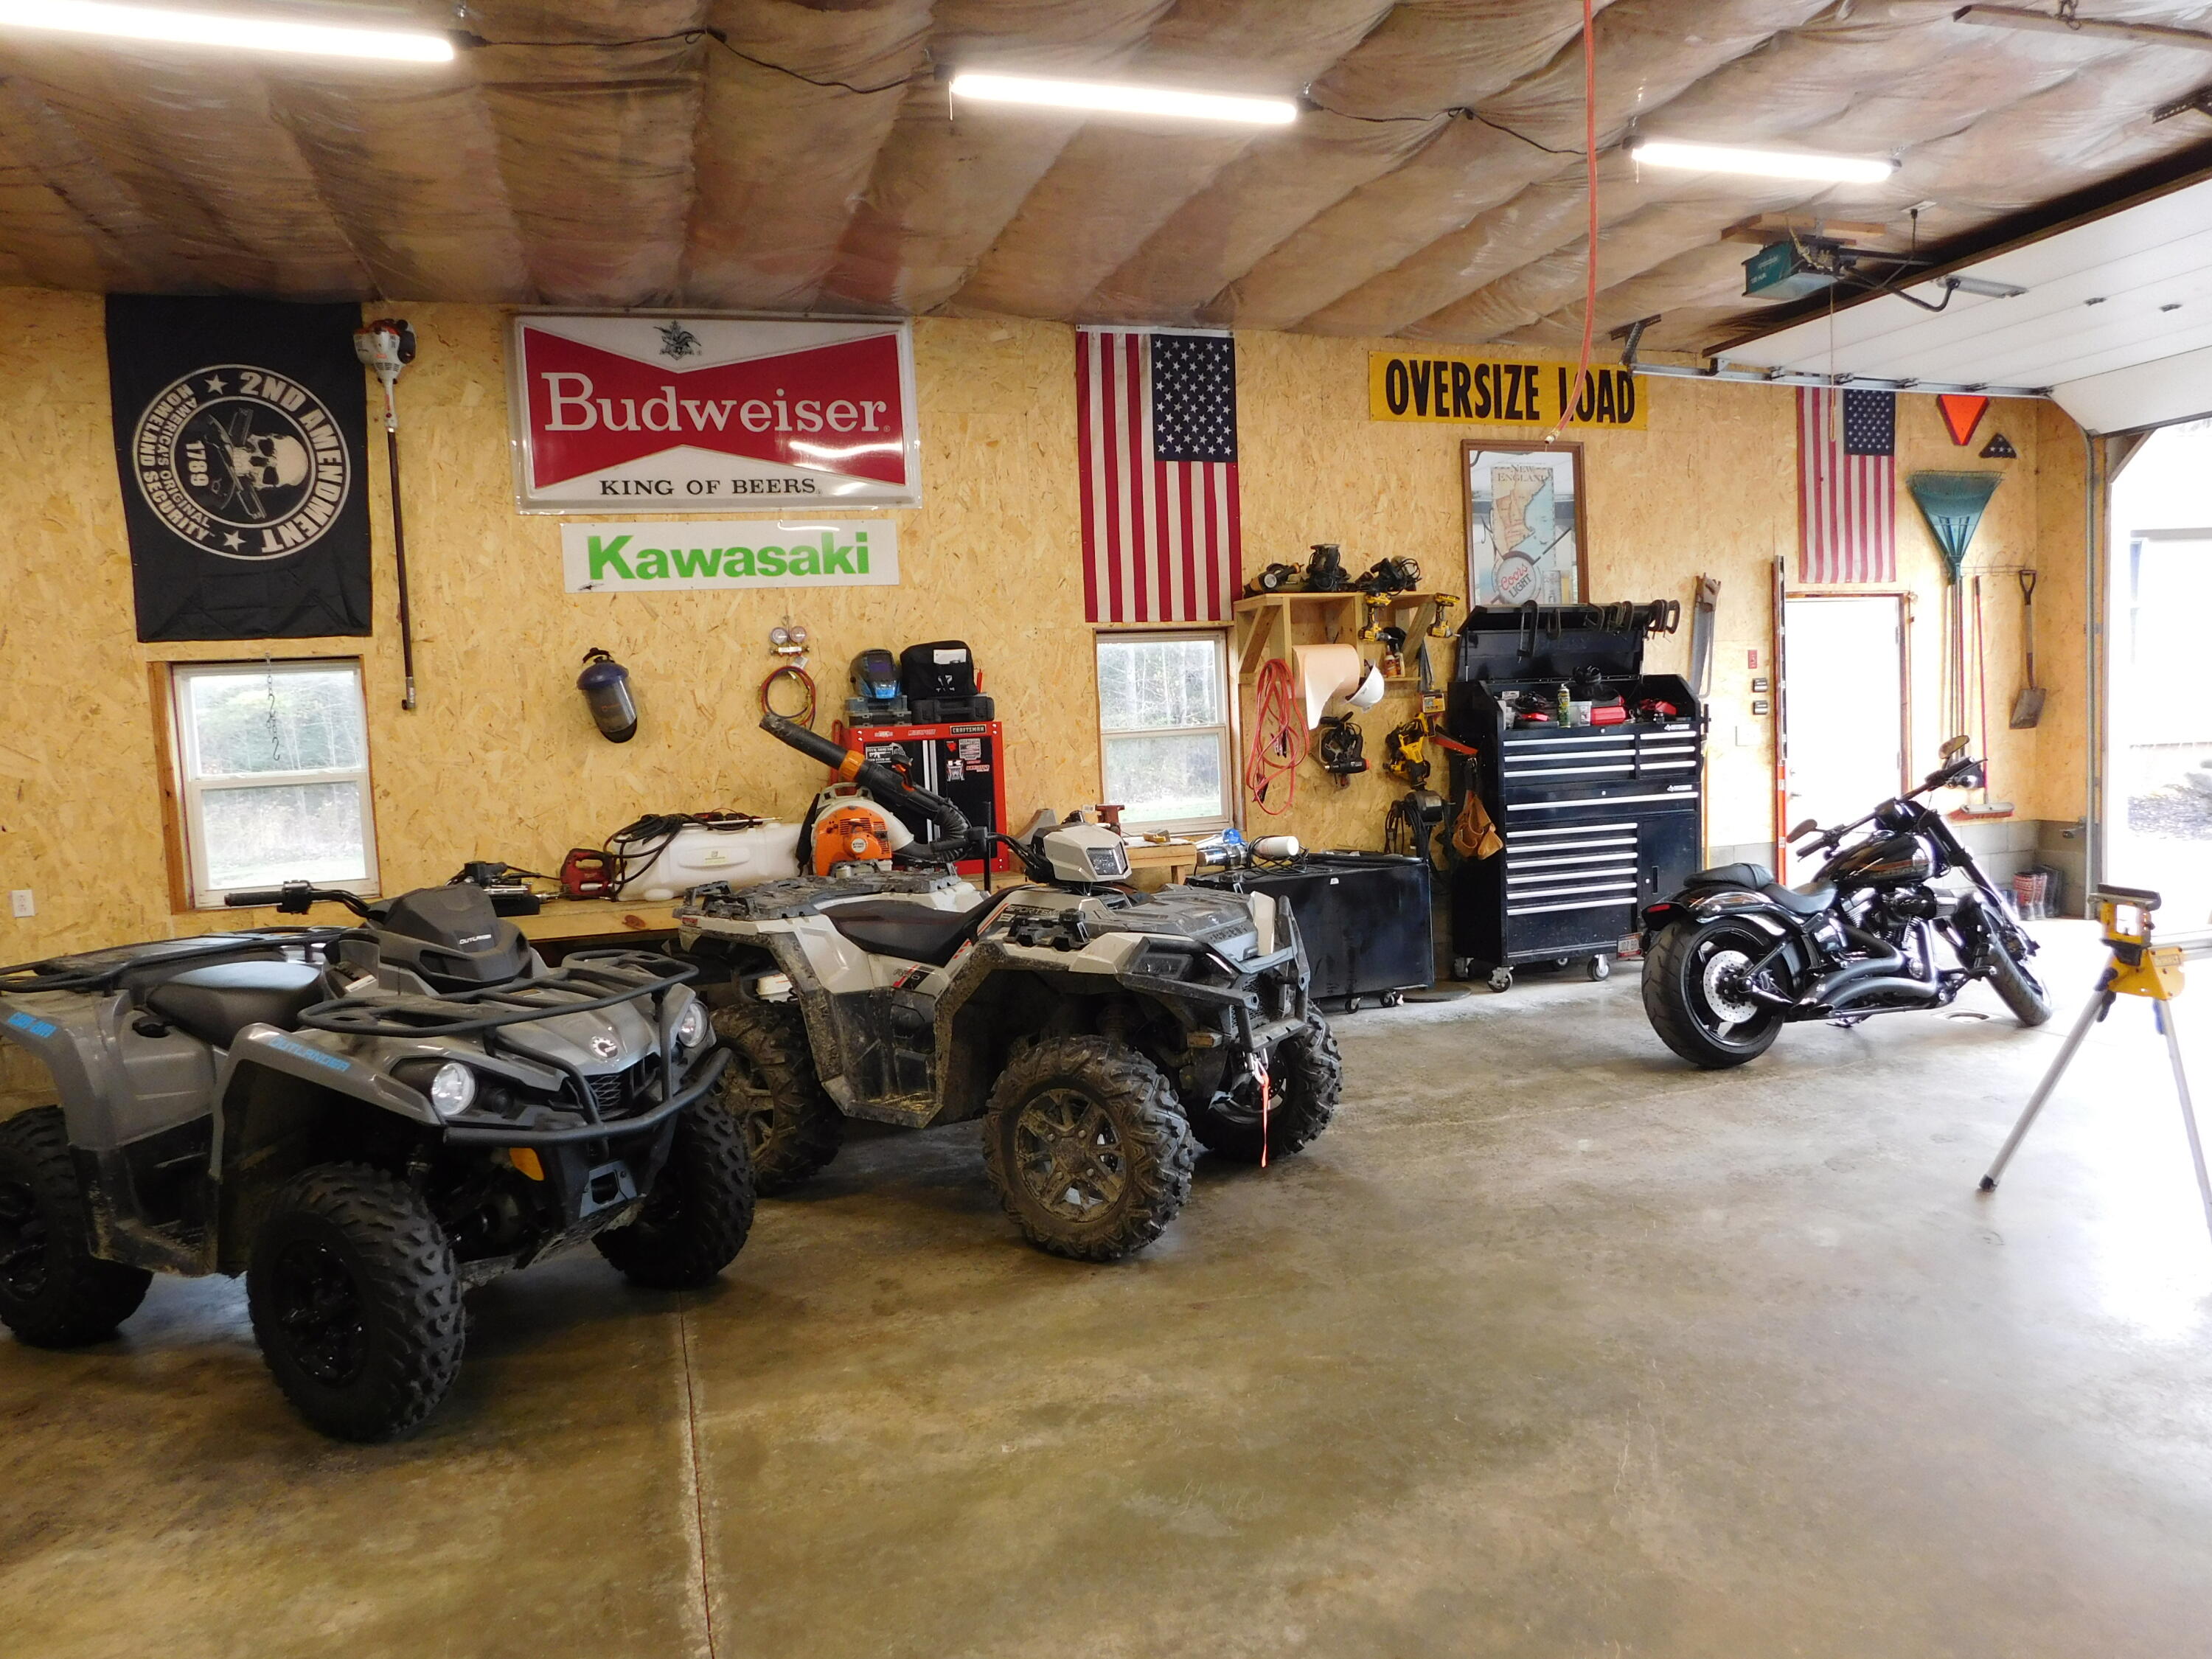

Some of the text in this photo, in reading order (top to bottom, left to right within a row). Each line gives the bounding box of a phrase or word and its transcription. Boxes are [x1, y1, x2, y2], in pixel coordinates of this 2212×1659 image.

[541, 371, 887, 433] Budweiser
[1385, 358, 1635, 424] OVERSIZE LOAD
[139, 383, 210, 541] HOMELAND SECURITY
[156, 397, 210, 528] AMERICA'S ORIGINAL
[186, 440, 209, 487] 1789
[240, 372, 343, 553] 2ND AMENDMENT
[599, 478, 816, 495] KING OF BEERS
[1511, 464, 1534, 473] NEW
[587, 531, 870, 581] Kawasaki
[1500, 563, 1528, 591] Coors
[1509, 574, 1532, 598] LIGHT
